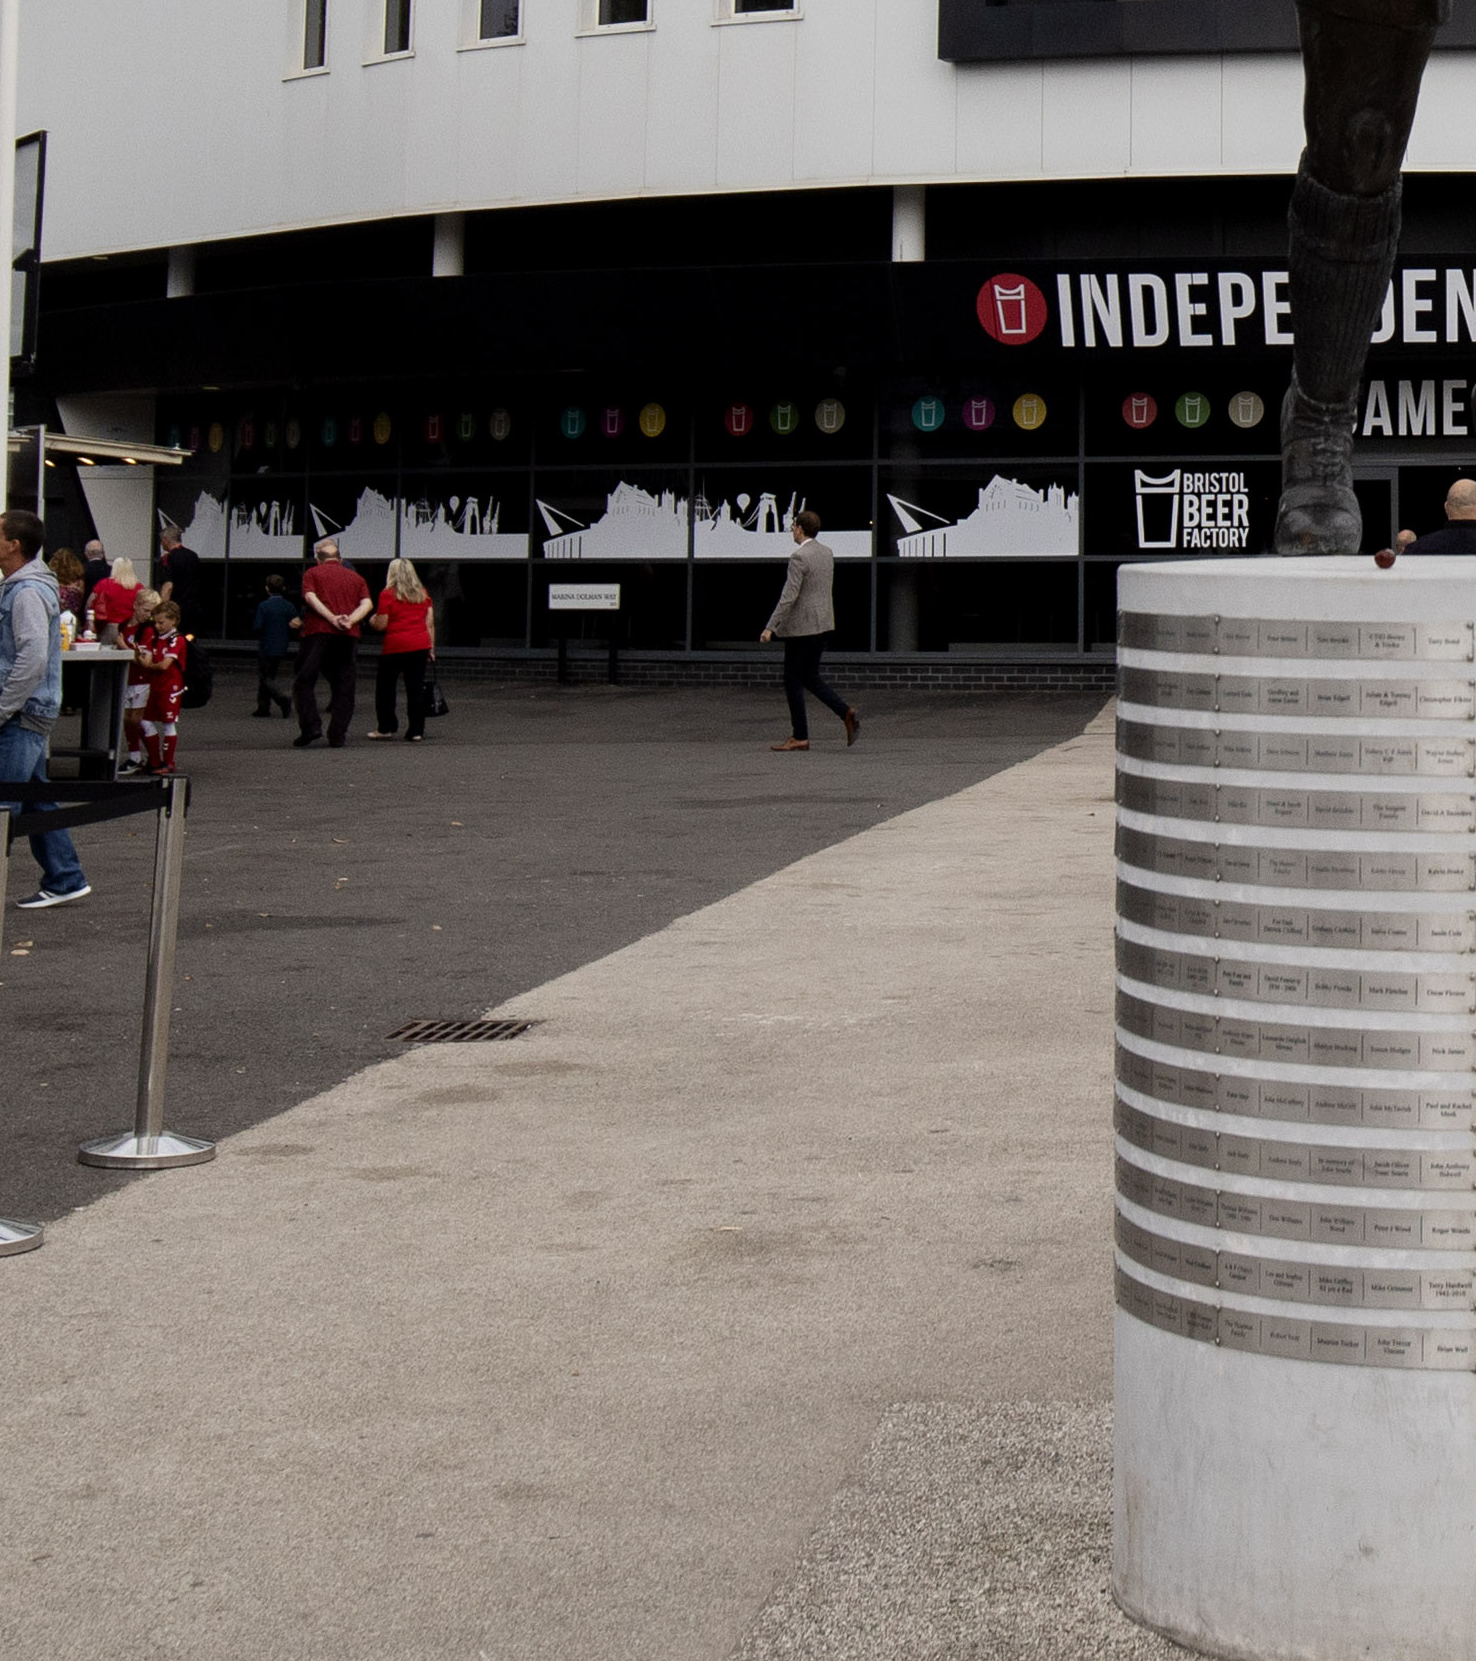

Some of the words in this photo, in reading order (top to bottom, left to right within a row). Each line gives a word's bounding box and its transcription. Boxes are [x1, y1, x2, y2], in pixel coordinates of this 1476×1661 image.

[1354, 379, 1468, 437] AME
[1183, 472, 1249, 494] BRISTOL
[1183, 494, 1249, 528] BEER
[1183, 528, 1249, 549] FACTORY
